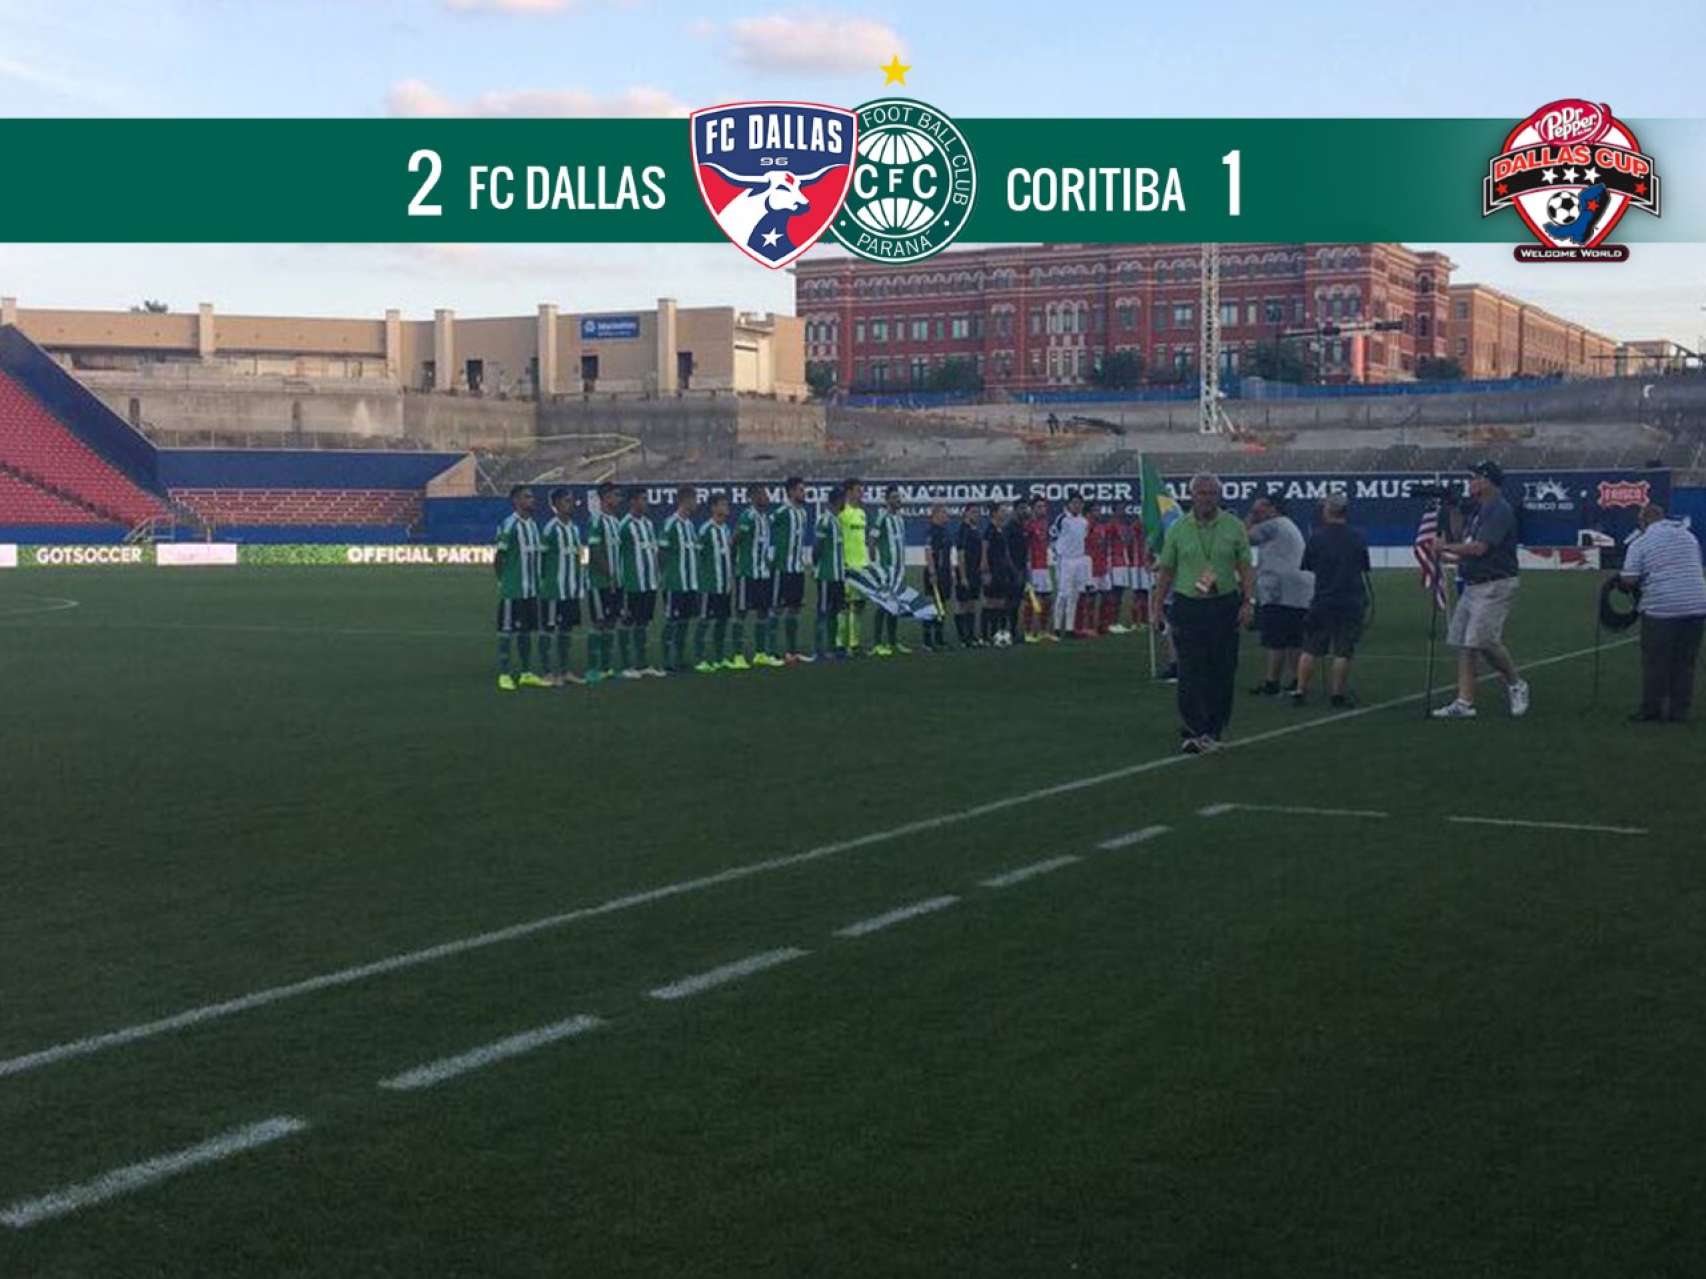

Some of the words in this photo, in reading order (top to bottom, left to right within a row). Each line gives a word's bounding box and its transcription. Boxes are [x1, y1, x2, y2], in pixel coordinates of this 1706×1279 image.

[860, 485, 890, 503] HE
[898, 484, 1022, 503] NATIONAL
[1029, 483, 1133, 501] SOCCER
[1222, 481, 1258, 499] OF
[1266, 480, 1347, 499] FAME
[1356, 479, 1471, 498] MUS
[36, 547, 142, 563] GOTSOCCER
[348, 547, 433, 564] OFFICIAL
[437, 545, 497, 563] PARTN
